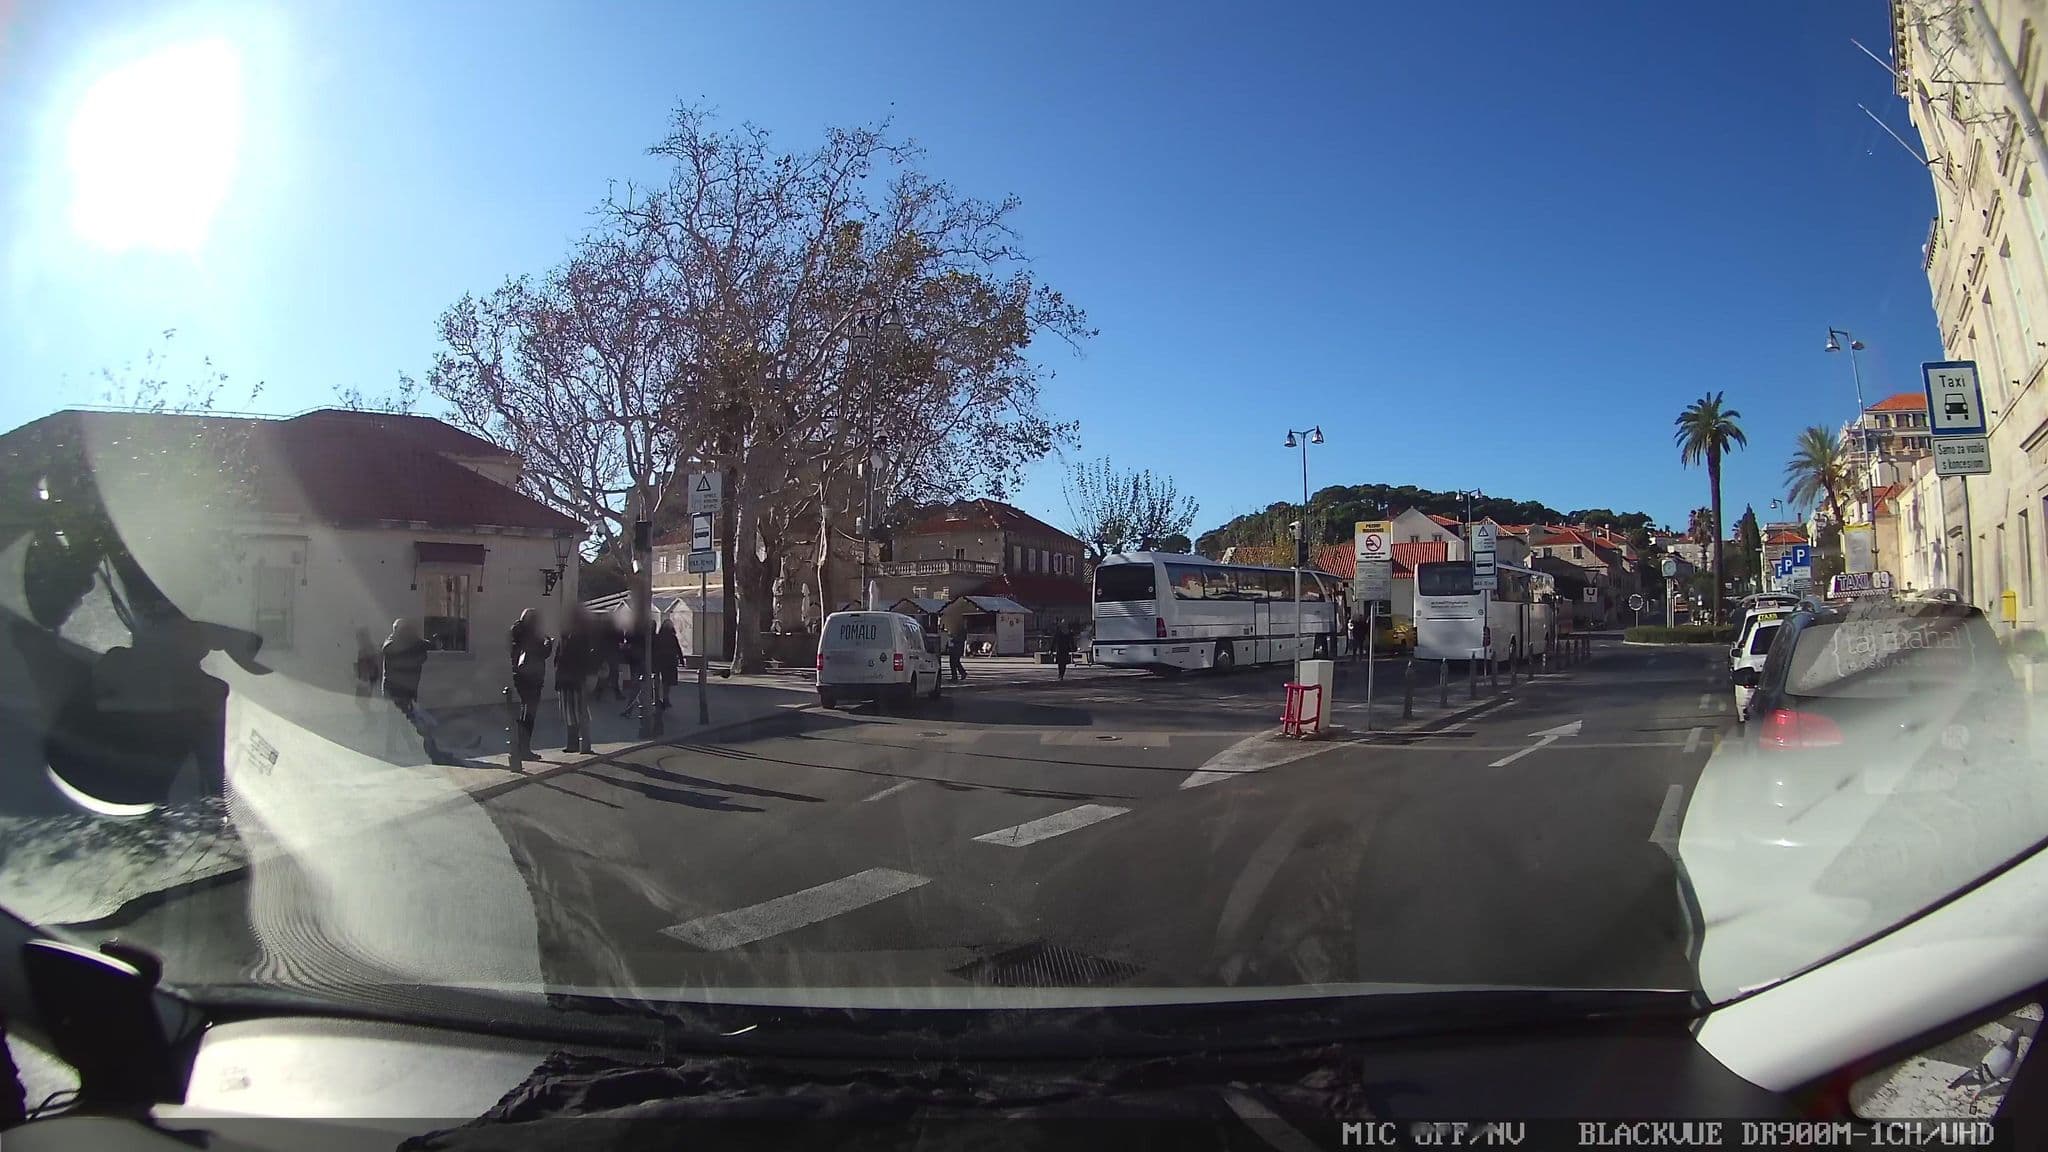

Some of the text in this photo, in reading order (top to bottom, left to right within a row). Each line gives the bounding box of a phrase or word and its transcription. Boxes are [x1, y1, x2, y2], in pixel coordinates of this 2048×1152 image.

[1938, 375, 1966, 388] Taxi
[1937, 444, 1956, 455] Samo
[1957, 445, 1965, 454] za
[1796, 549, 1805, 564] P
[1784, 559, 1792, 572] P
[1837, 573, 1869, 591] TAXI
[840, 623, 877, 640] POMALO
[1881, 624, 1961, 651] mahal
